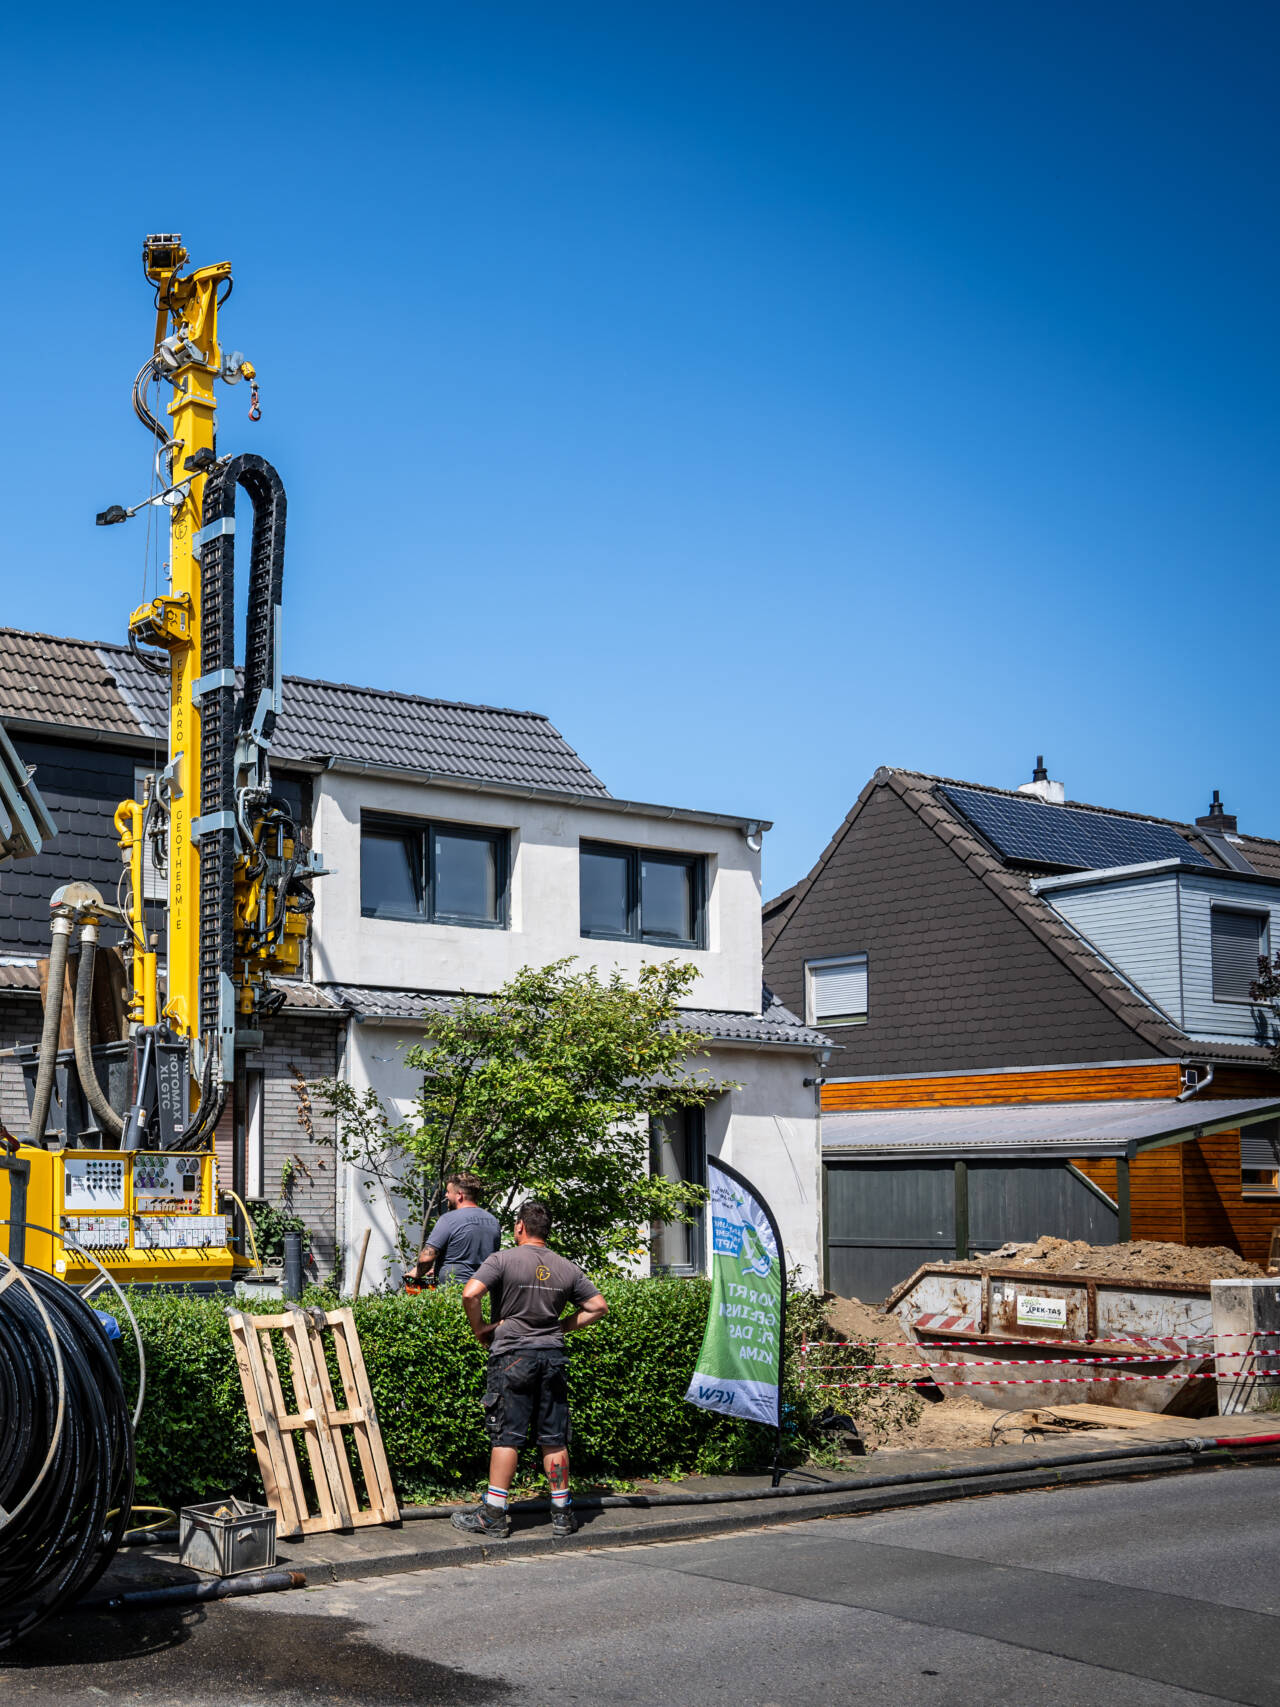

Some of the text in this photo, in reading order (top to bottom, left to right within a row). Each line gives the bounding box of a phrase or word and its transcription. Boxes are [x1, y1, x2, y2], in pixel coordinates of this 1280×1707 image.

[176, 659, 184, 742] FERRARO
[175, 810, 183, 930] GEOTHERMIE
[160, 1065, 171, 1110] XL GTC
[169, 1053, 182, 1120] ROTOMAX
